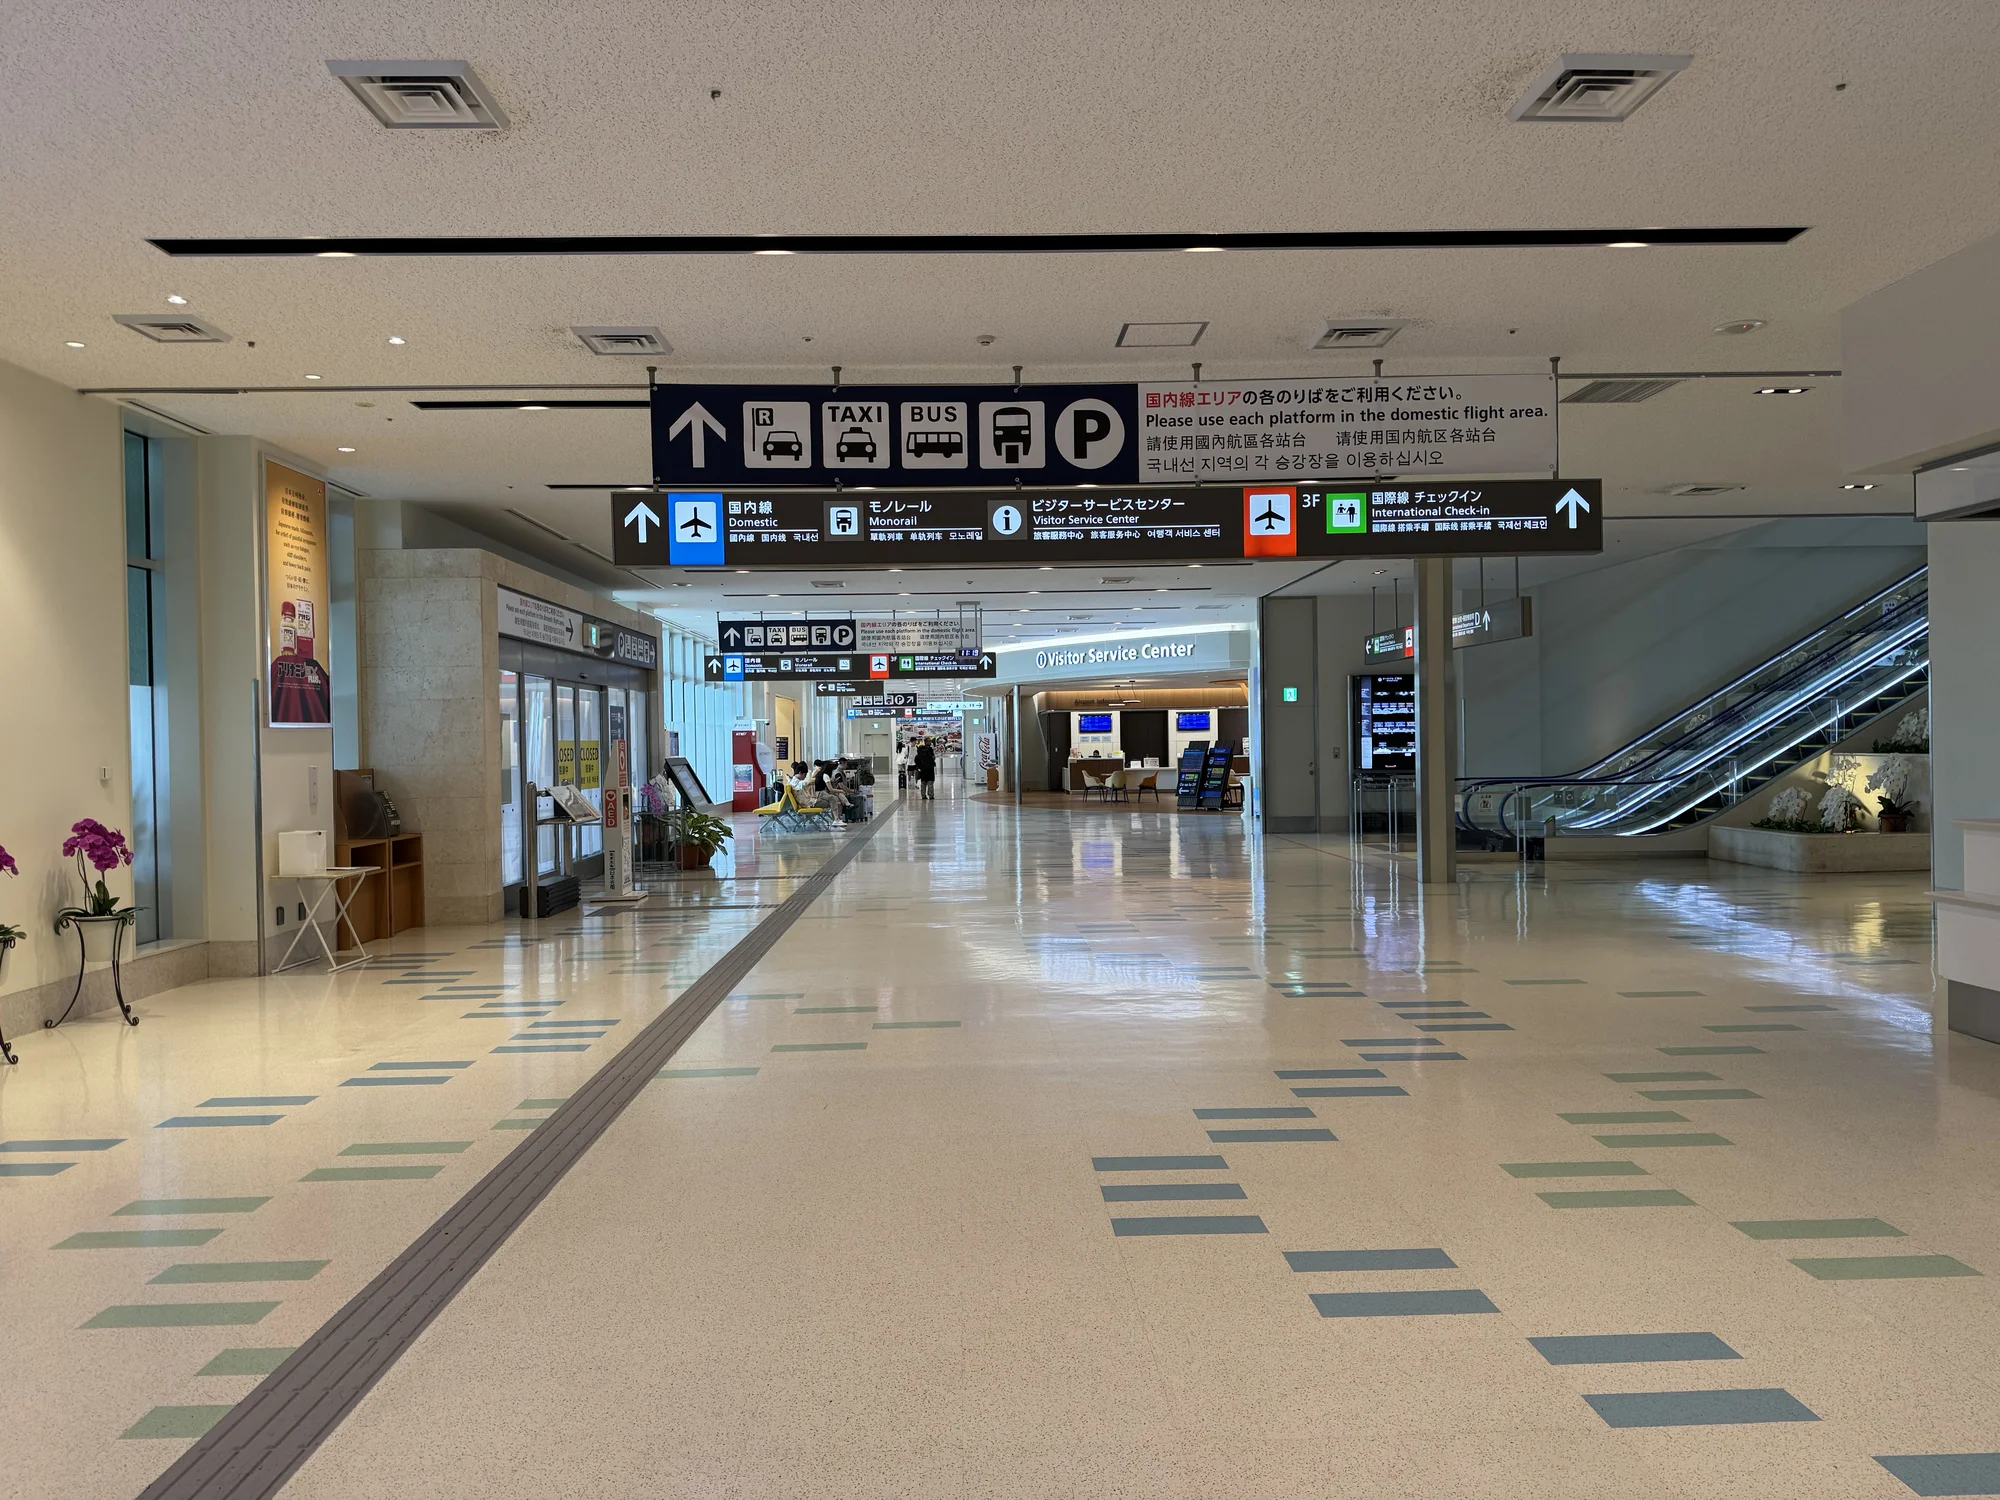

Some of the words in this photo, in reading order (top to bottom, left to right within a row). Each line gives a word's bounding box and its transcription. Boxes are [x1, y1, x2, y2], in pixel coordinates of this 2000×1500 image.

[1145, 386, 1462, 408] 国内線エリアの各のりばをご利用ください。
[828, 406, 883, 423] TAXI
[911, 405, 957, 423] BUS
[1146, 414, 1193, 427] Please
[1198, 415, 1224, 426] use
[1229, 411, 1264, 425] each
[1269, 409, 1335, 427] platform
[1341, 409, 1355, 422] in
[1360, 407, 1386, 422] the
[1390, 407, 1459, 421] domestic
[1464, 405, 1505, 422] flight
[1509, 407, 1548, 419] area.
[1073, 409, 1111, 459] P
[1336, 427, 1496, 447] 请使用国内航区各站台
[1146, 457, 1195, 473] 국내선
[1201, 455, 1248, 472] 지역의
[1254, 454, 1269, 470] 각
[1275, 453, 1340, 470] 승강장을
[1346, 450, 1444, 468] 이용하십시오
[1302, 494, 1320, 508] 3F
[1372, 492, 1410, 505] 国際線
[1414, 490, 1482, 504] チェックイン
[728, 500, 773, 514] 国内線
[869, 500, 932, 513] モノレール
[1032, 498, 1185, 512] ビジターサービスセンター
[1372, 507, 1441, 517] International
[1444, 506, 1490, 516] Check-in
[729, 517, 778, 527] Domestic
[869, 515, 917, 526] Monorail
[1033, 515, 1066, 525] Visitor
[1068, 514, 1103, 524] Service
[1105, 514, 1139, 524] Center
[1497, 520, 1521, 530] 국제선
[1523, 519, 1547, 530] 체크인
[949, 531, 983, 541] 모노레일
[1147, 529, 1173, 538] 여행객
[1175, 529, 1201, 538] 서비스
[1203, 528, 1221, 538] 센터
[838, 629, 850, 642] P
[1048, 651, 1086, 667] Visitor
[1088, 645, 1137, 664] Service
[1141, 642, 1195, 660] Center
[580, 748, 598, 761] CLOSED
[979, 735, 990, 770] Coca-Cola
